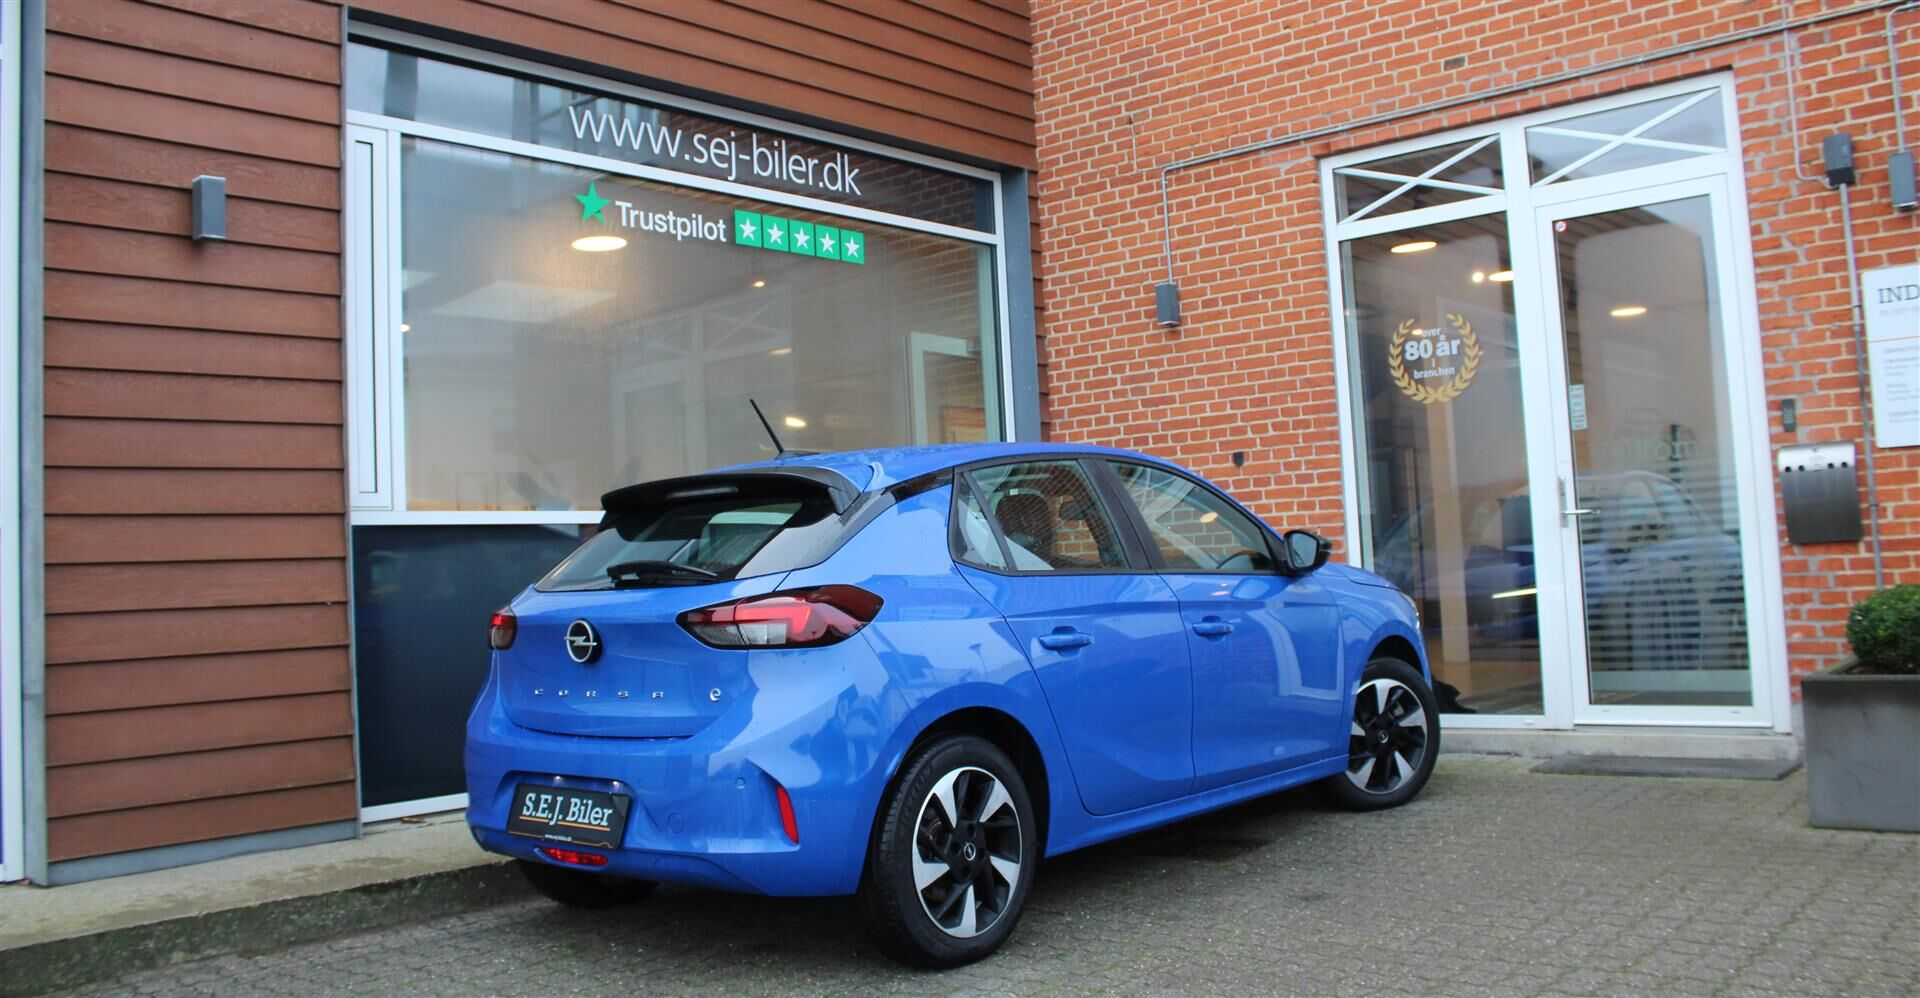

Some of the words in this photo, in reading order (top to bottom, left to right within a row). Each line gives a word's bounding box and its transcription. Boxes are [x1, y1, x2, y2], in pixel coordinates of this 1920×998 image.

[569, 106, 861, 196] www.sej-biler.dk
[615, 200, 727, 242] Trustpilot
[1422, 328, 1440, 337] over
[1405, 340, 1432, 361] 80
[1436, 334, 1460, 356] år
[1413, 367, 1455, 380] branchen
[534, 687, 664, 699] CORSA
[522, 792, 563, 826] S.E.J.
[566, 797, 613, 827] Biler
